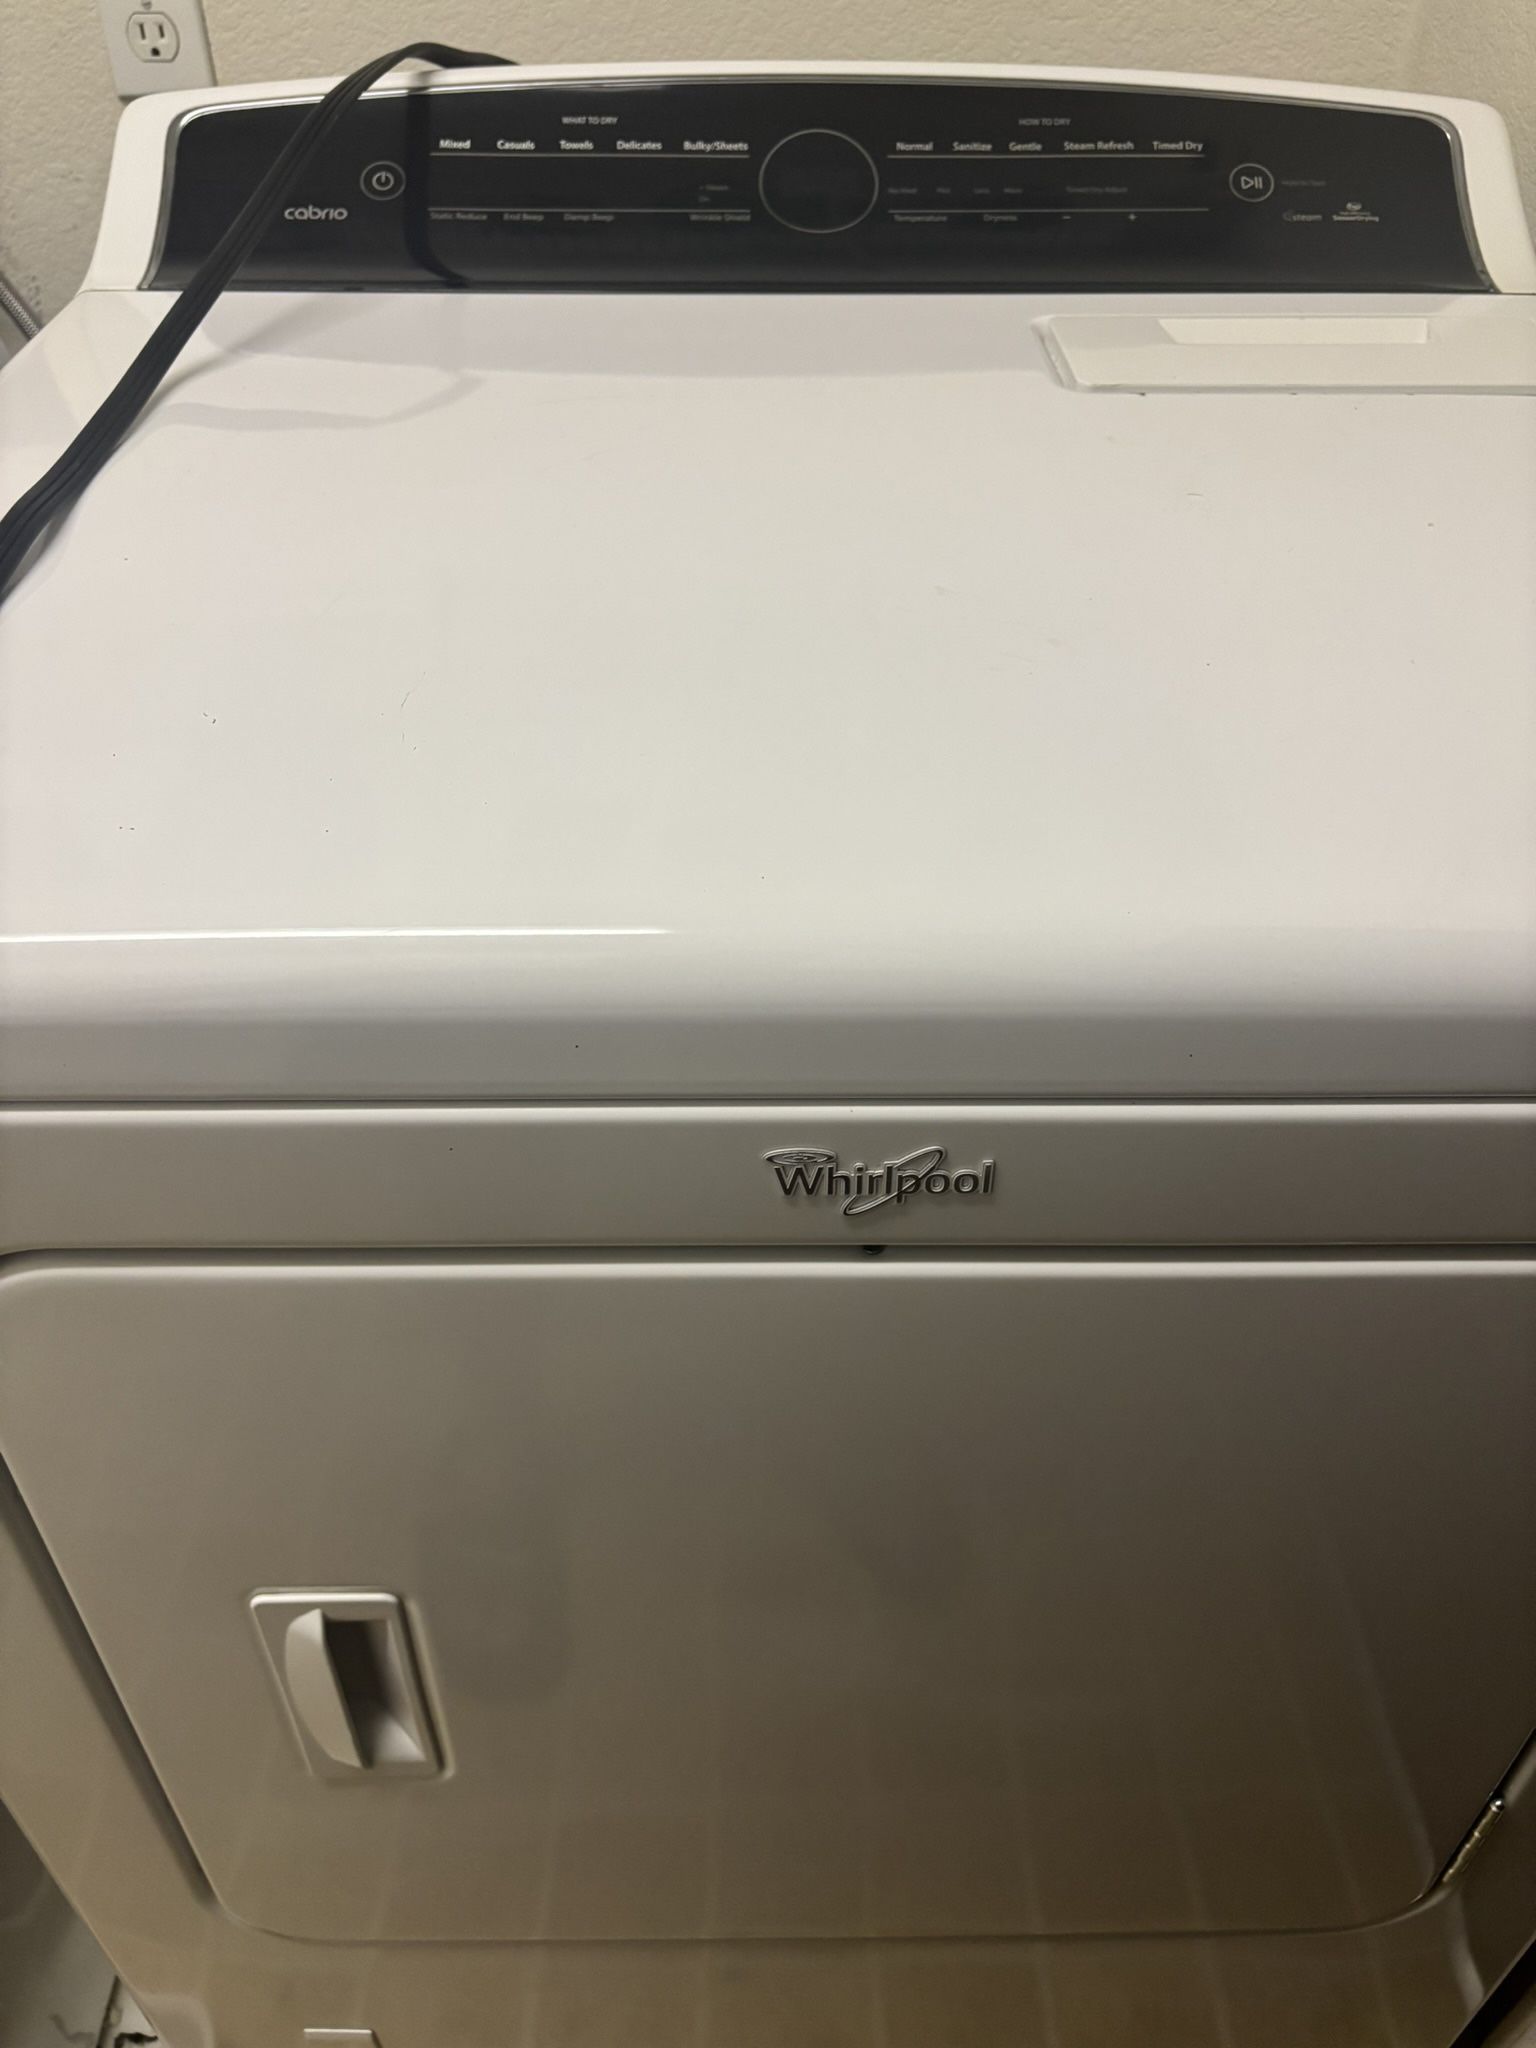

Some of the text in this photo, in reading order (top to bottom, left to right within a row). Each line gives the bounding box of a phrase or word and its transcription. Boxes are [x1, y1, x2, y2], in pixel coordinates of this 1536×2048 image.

[588, 116, 600, 124] TO
[601, 116, 618, 124] DRY
[1018, 118, 1071, 126] HOW TO DRY
[439, 139, 471, 149] Mixed
[497, 140, 535, 150] Casuals
[559, 140, 594, 150] Towels
[616, 140, 663, 150] Delicates
[683, 140, 749, 152] Bulky/Sheets
[896, 142, 934, 151] Normal
[952, 142, 993, 151] Sanitize
[1008, 142, 1043, 151] Gentle
[1064, 140, 1135, 151] Steam Refresh
[1152, 141, 1203, 152] Timed Dry
[284, 204, 348, 220] cabrio
[774, 1159, 996, 1204] Whirlpool
